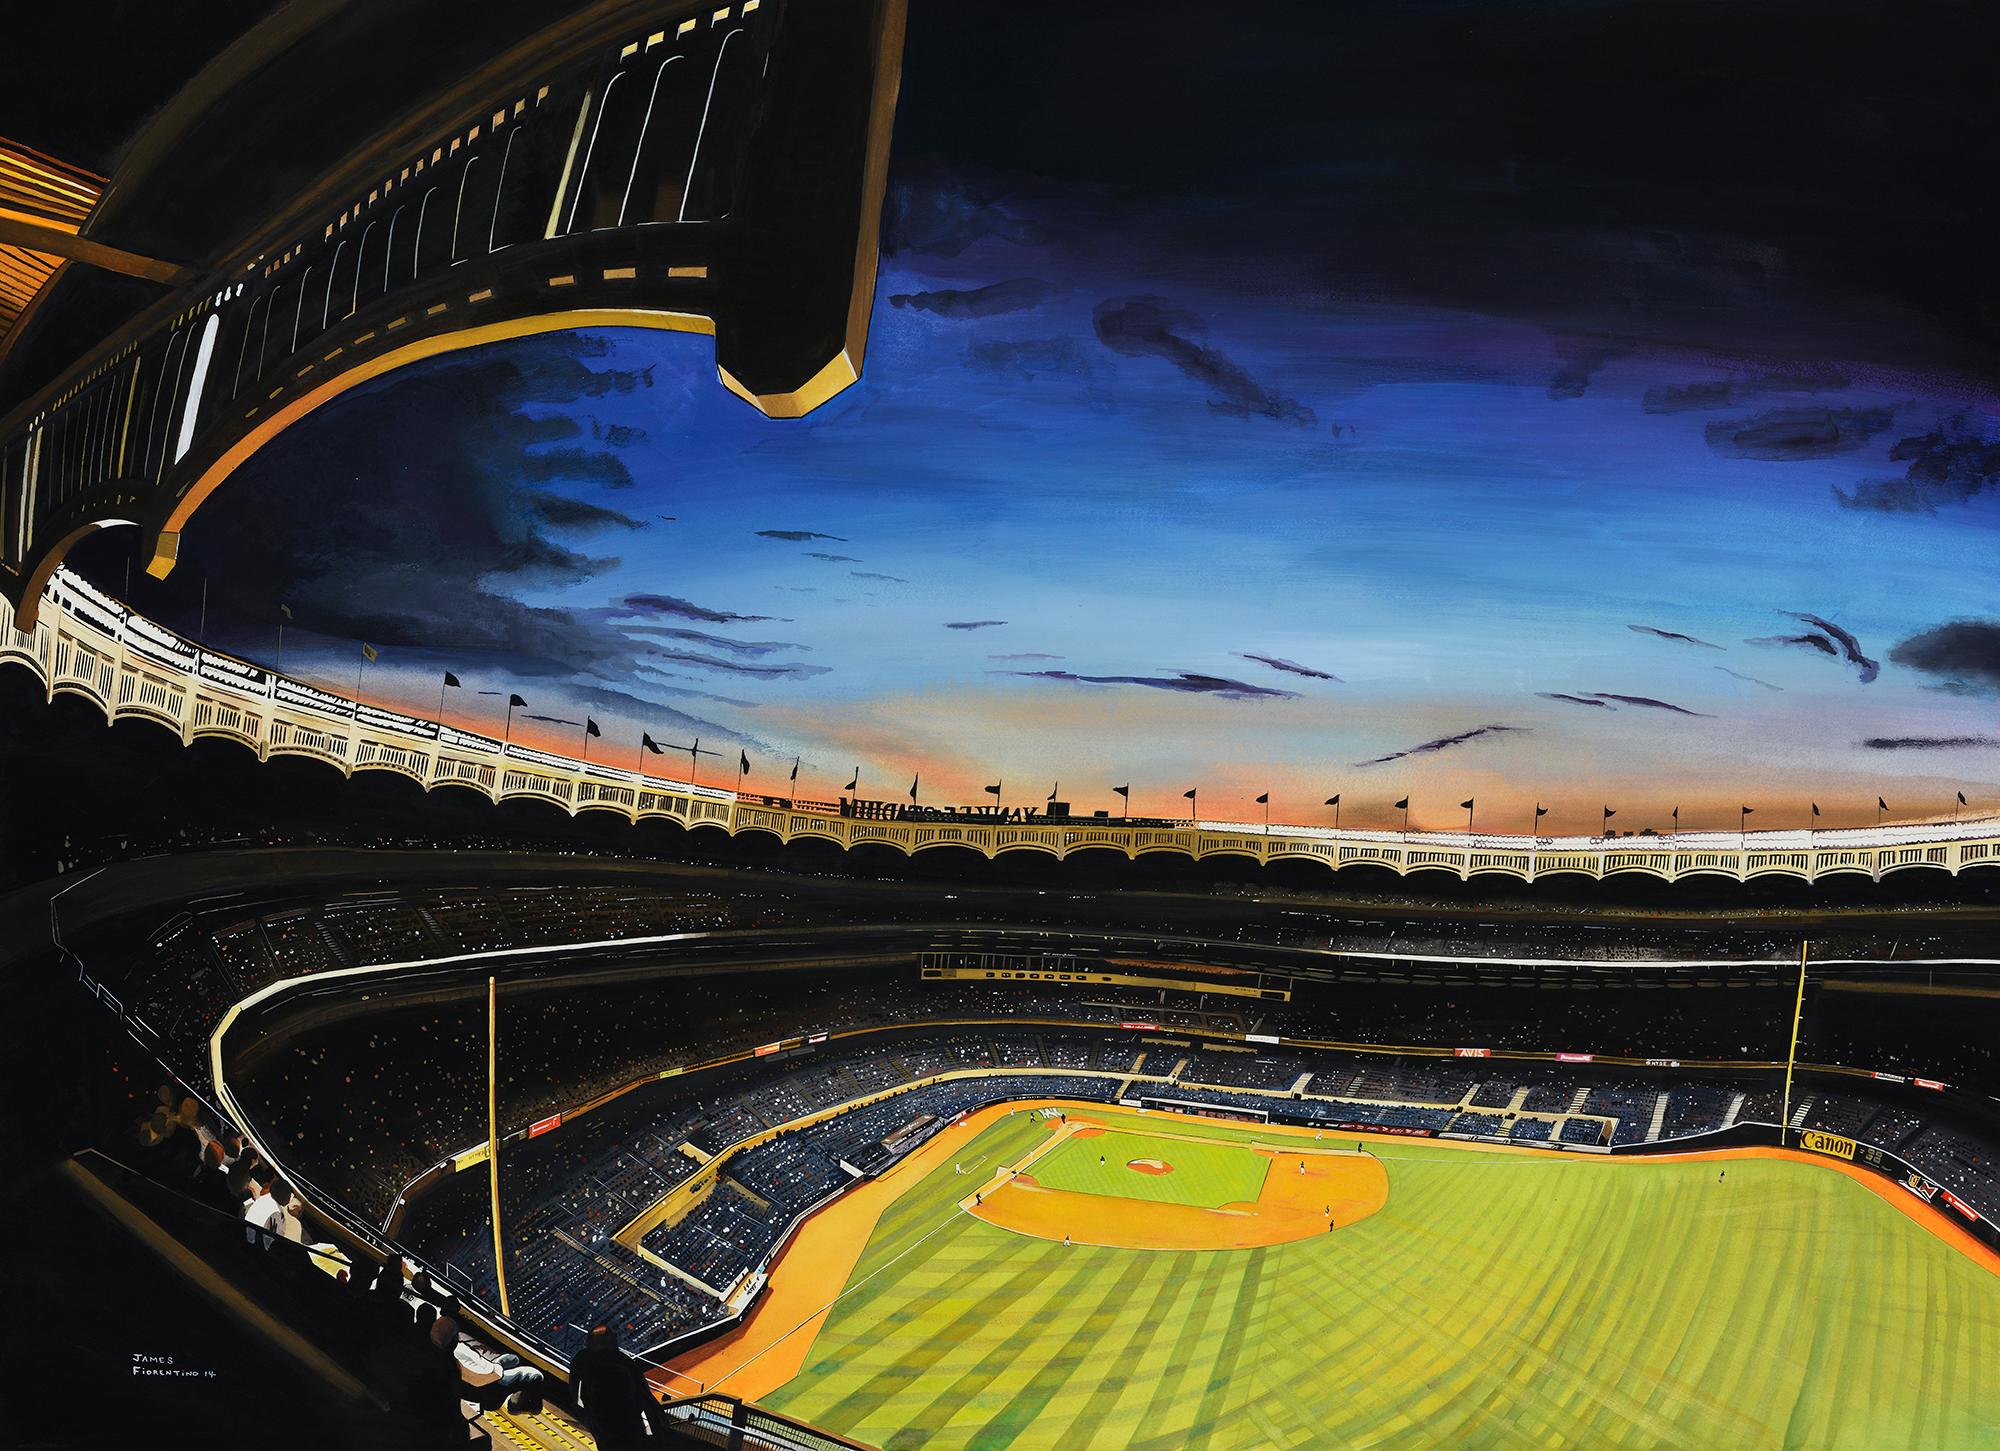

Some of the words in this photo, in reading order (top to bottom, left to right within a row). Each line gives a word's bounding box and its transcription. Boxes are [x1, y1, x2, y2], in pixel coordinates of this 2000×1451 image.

[1459, 1049, 1485, 1057] AVIS
[1801, 1131, 1853, 1155] Canon
[132, 1353, 173, 1364] JAMES
[204, 1370, 217, 1379] 14
